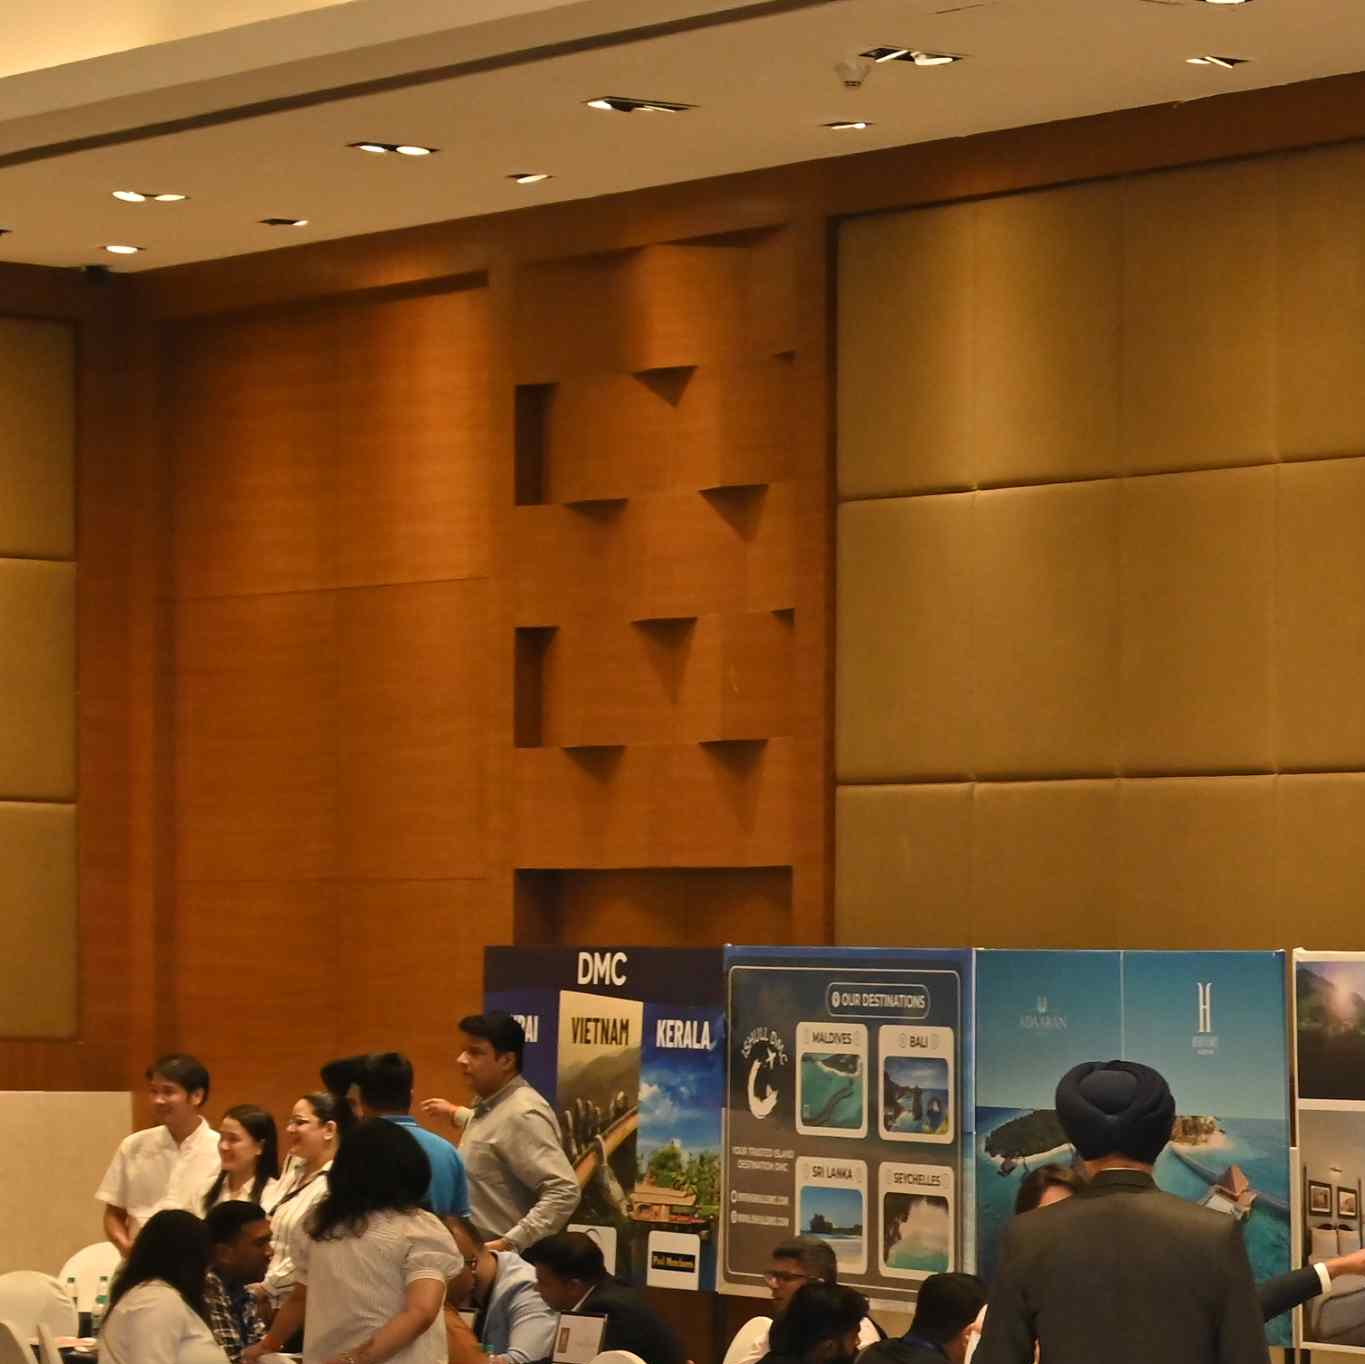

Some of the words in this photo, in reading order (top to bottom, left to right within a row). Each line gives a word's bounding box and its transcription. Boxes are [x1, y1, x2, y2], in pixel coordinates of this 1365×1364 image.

[577, 951, 627, 986] DMC
[841, 991, 861, 1007] OUR
[862, 993, 926, 1009] DESTINATIONS
[570, 1016, 630, 1046] VIETNAM
[655, 1019, 712, 1050] KERALA
[812, 1030, 853, 1046] MALDIVES
[909, 1034, 929, 1049] BALI
[811, 1165, 825, 1179] SRI
[826, 1167, 853, 1181] LANKA
[893, 1171, 941, 1187] SEYCHELLES
